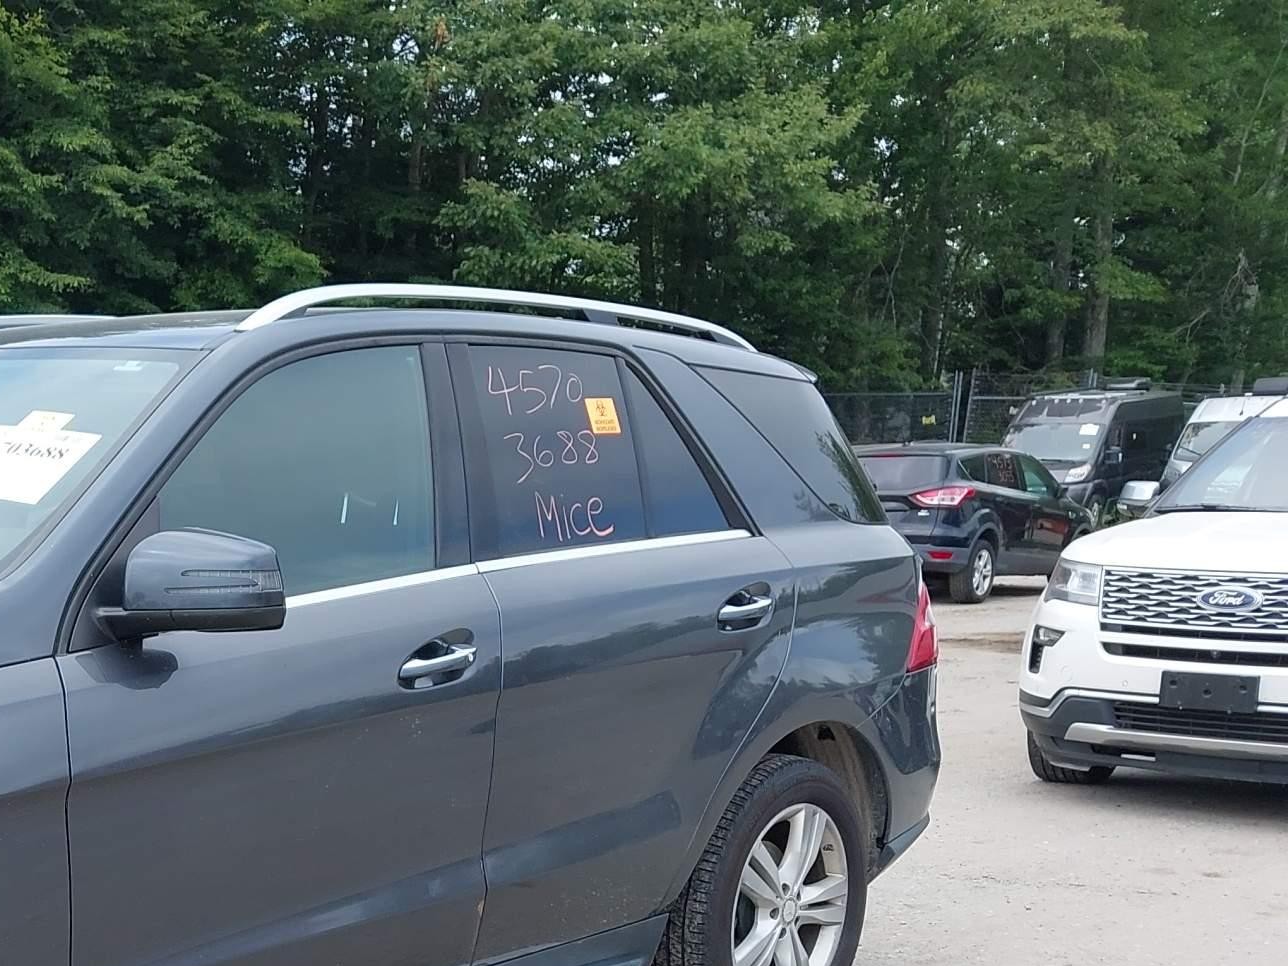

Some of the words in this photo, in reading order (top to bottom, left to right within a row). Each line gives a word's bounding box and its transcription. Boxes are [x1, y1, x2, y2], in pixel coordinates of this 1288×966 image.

[488, 365, 583, 415] 4570
[503, 430, 599, 483] 3688
[534, 491, 614, 542] Mice
[1208, 591, 1245, 605] Ford
